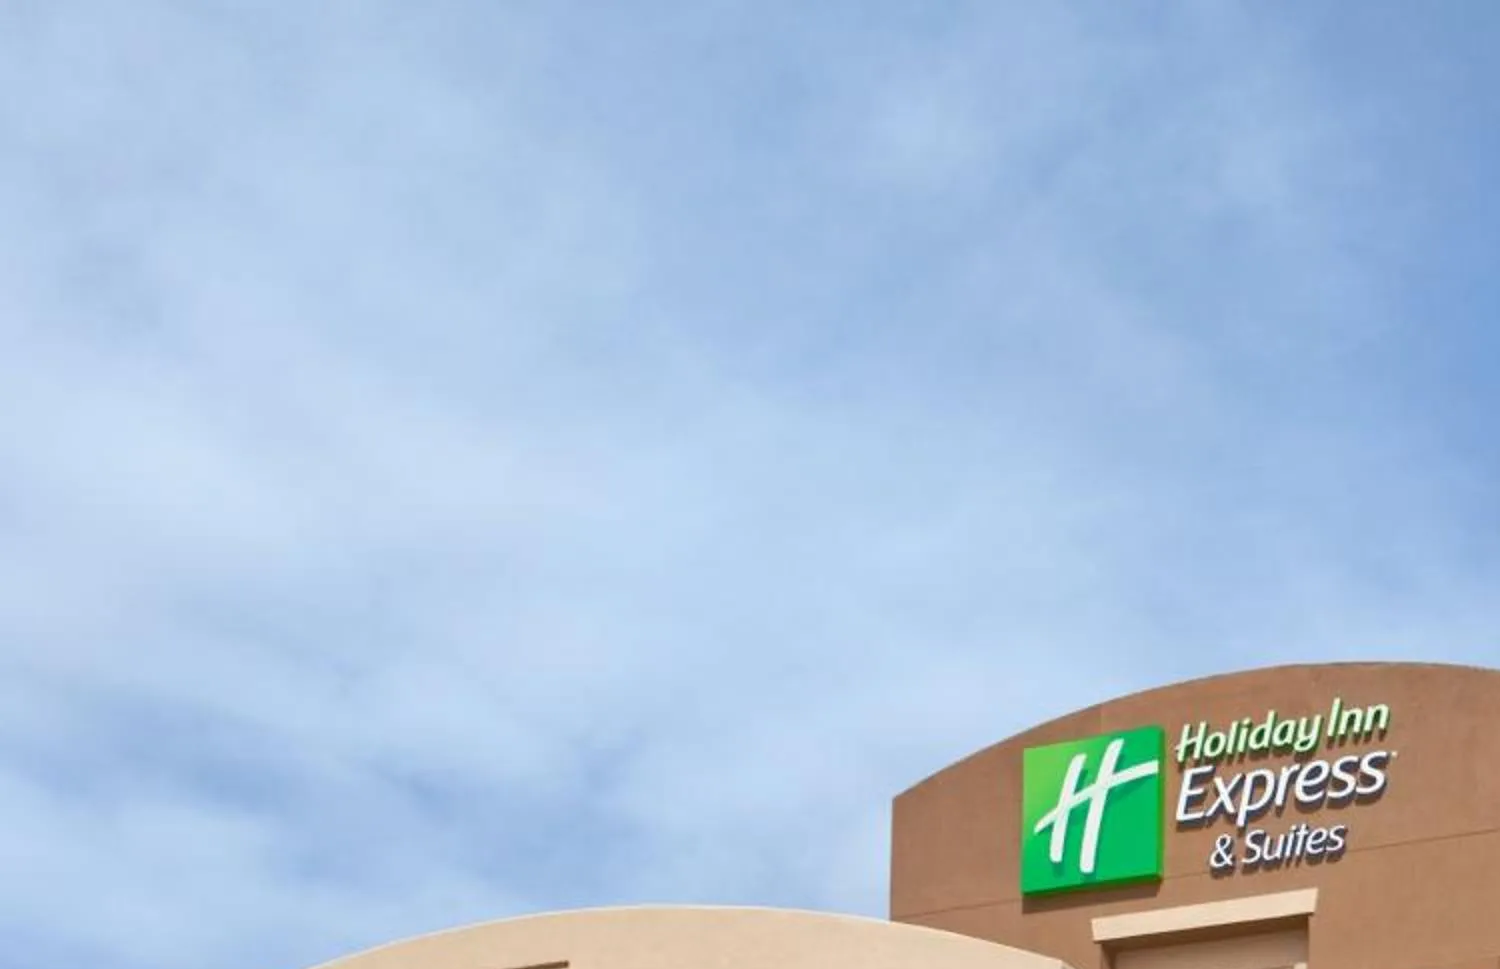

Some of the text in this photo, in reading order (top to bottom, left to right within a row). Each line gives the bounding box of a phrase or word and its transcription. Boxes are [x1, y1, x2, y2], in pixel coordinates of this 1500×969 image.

[1175, 697, 1390, 762] Holiday Inn
[1174, 750, 1389, 827] Express
[1208, 824, 1346, 868] & Suites
